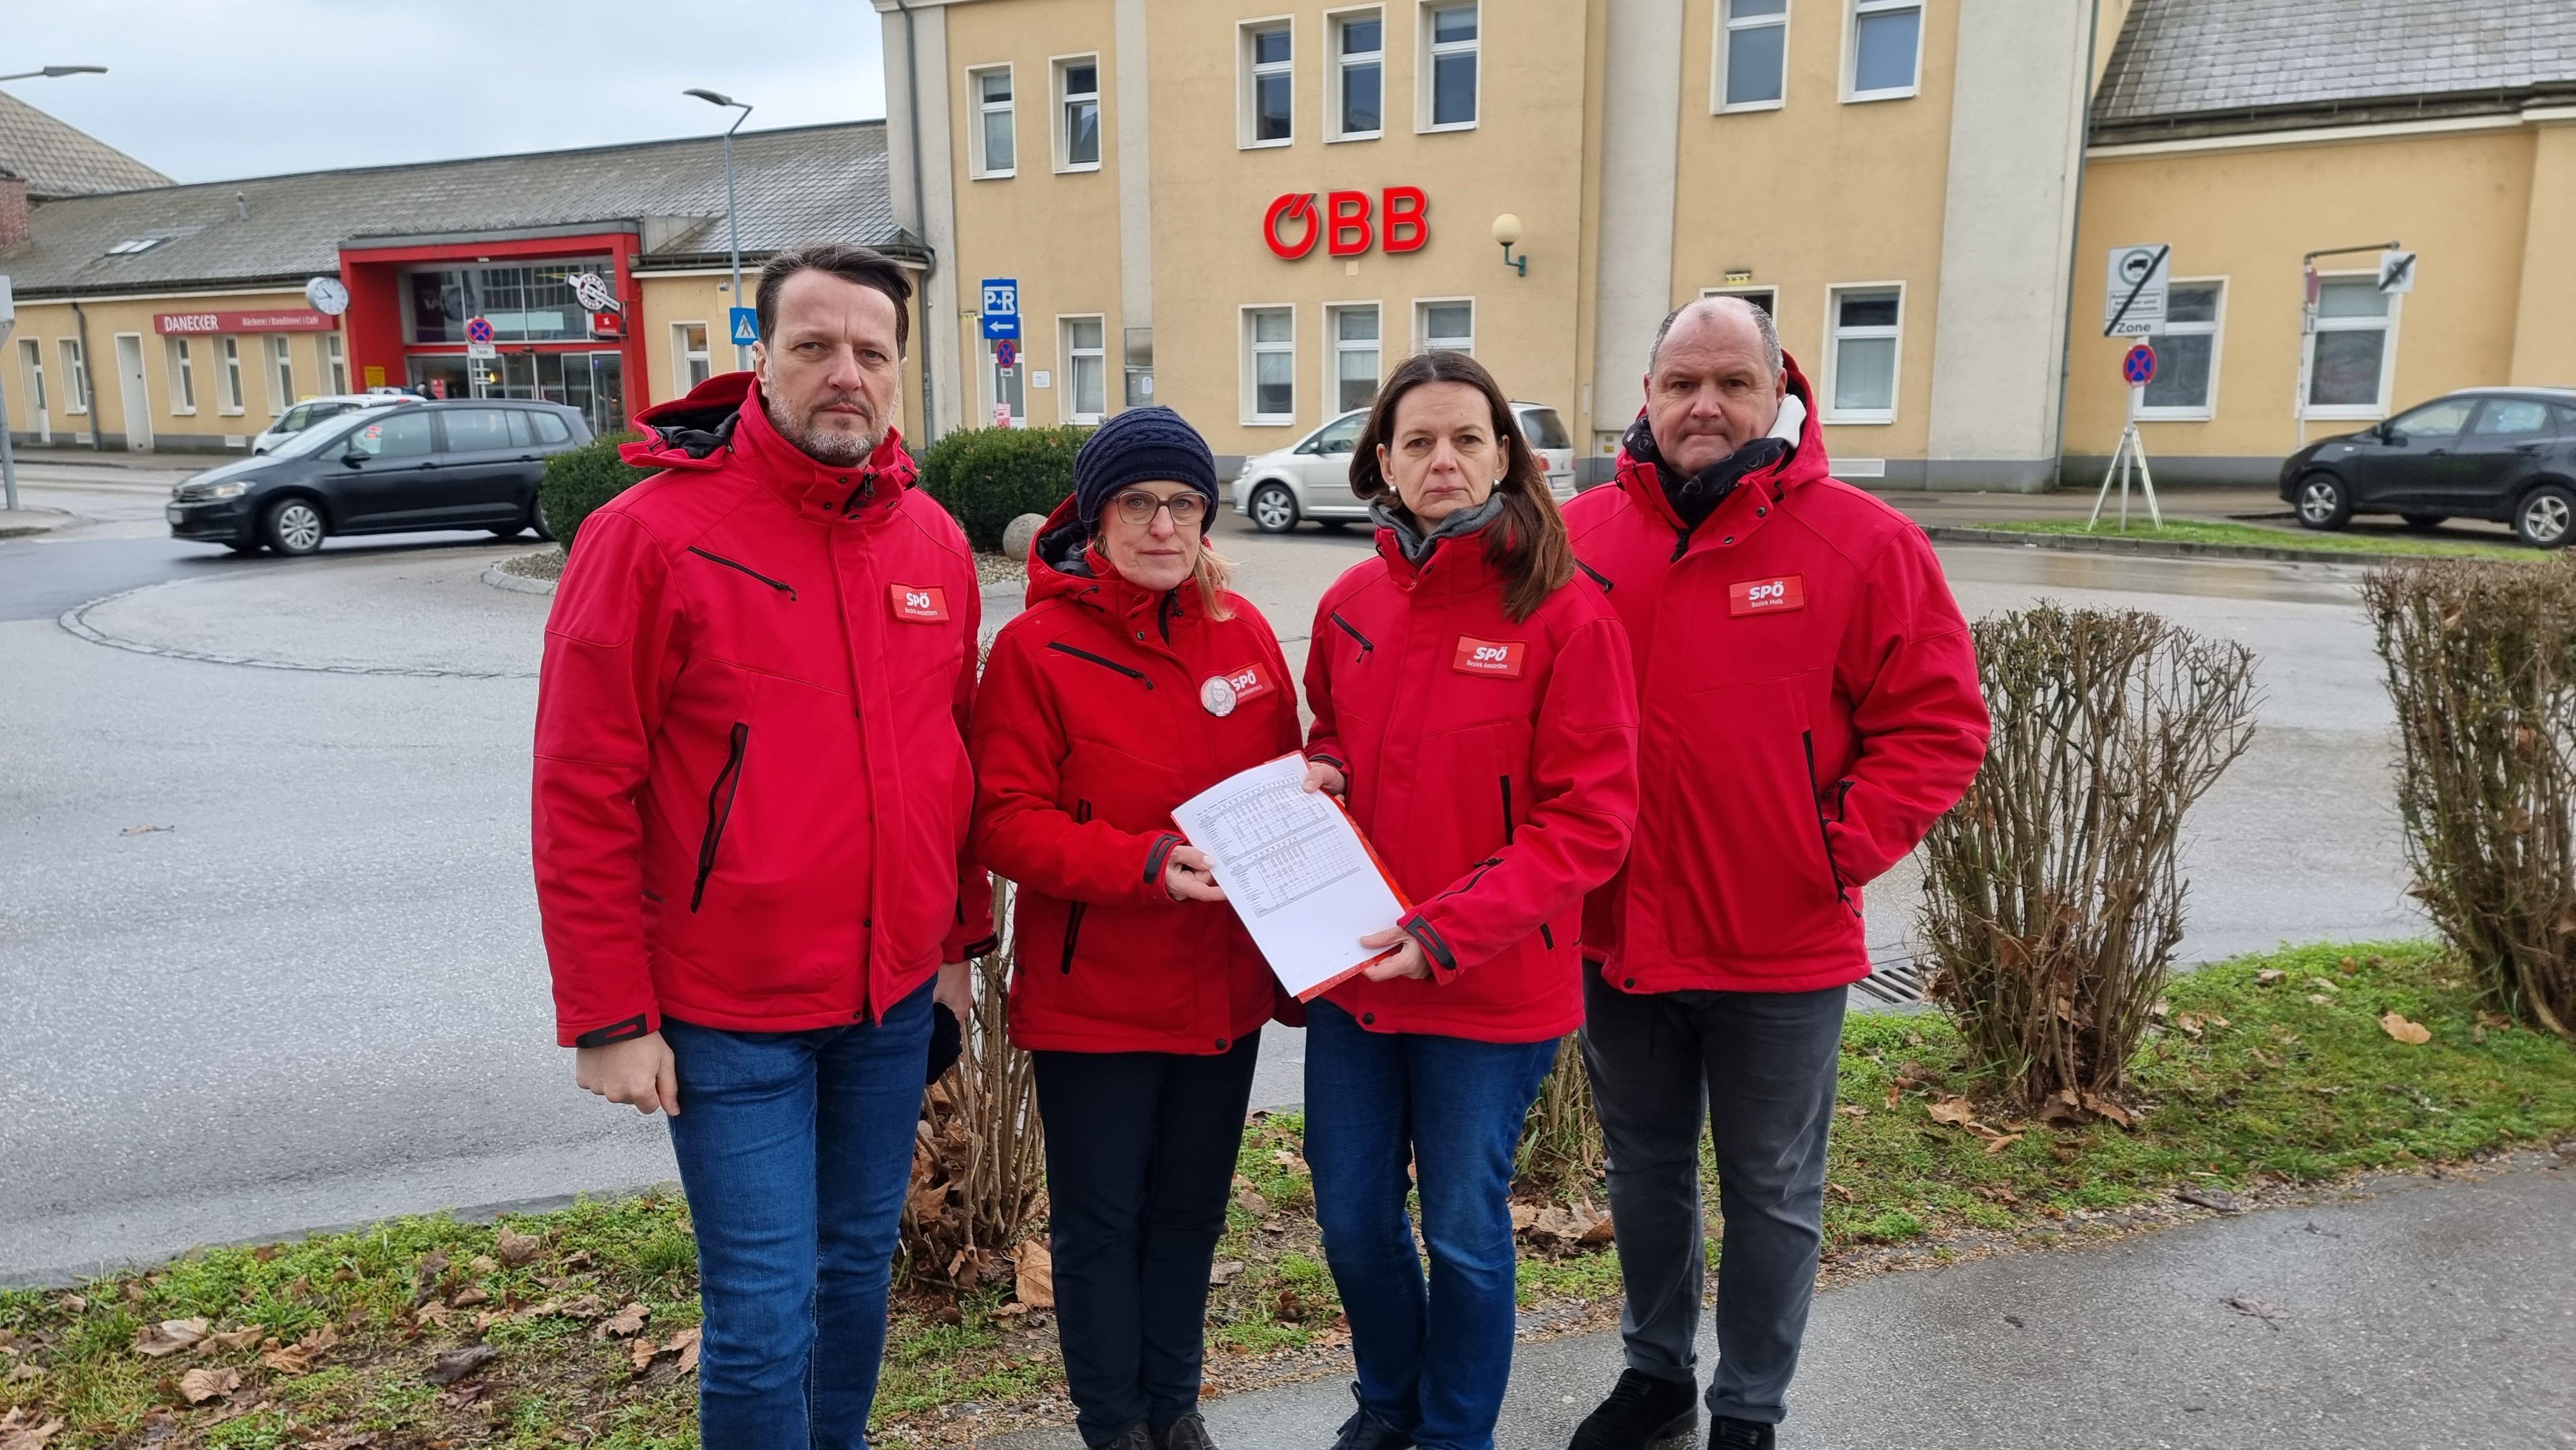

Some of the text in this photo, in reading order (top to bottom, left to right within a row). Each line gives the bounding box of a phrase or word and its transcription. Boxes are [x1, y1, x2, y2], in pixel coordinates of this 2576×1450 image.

[1264, 185, 1429, 260] ÖBB
[983, 291, 1016, 310] P+R
[164, 314, 219, 332] DANECKER
[242, 317, 268, 326] Bäckerei
[271, 316, 302, 326] Konditorei
[2117, 322, 2152, 333] Zone
[1748, 581, 1785, 600] SPÖ
[905, 592, 930, 608] SPÖ
[1473, 646, 1508, 661] SPÖ
[1466, 659, 1482, 668] Bezirk
[1231, 669, 1256, 692] SPÖ
